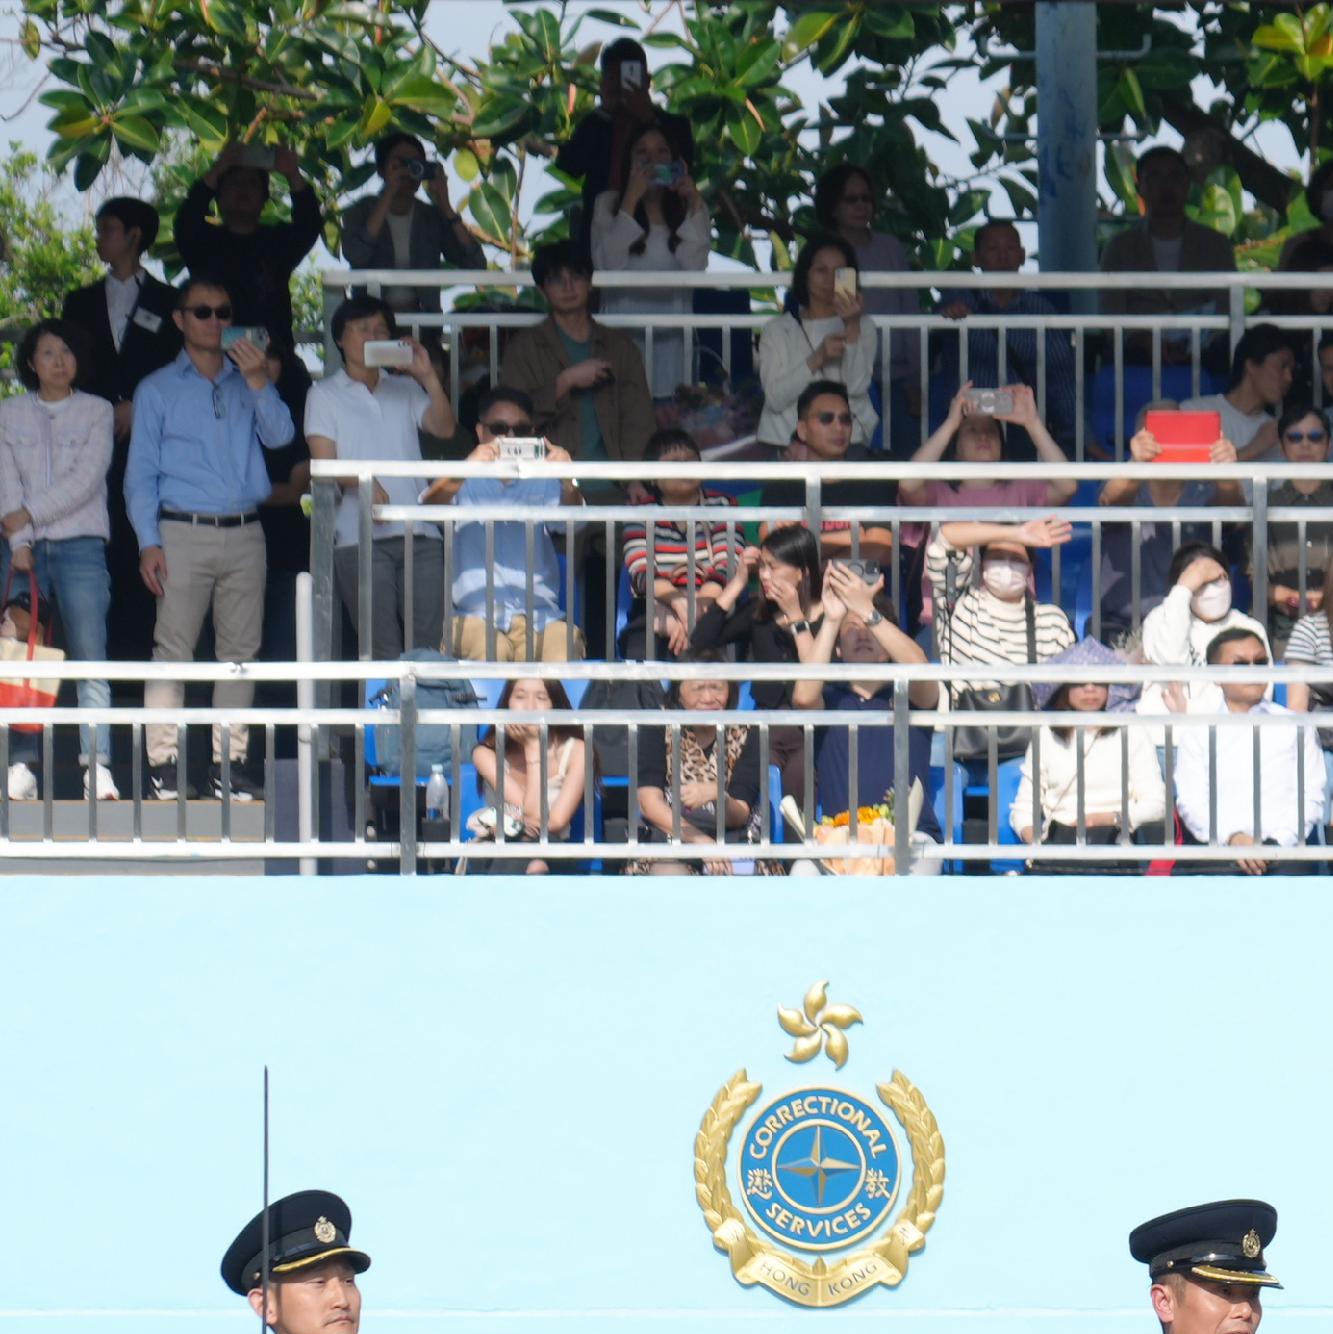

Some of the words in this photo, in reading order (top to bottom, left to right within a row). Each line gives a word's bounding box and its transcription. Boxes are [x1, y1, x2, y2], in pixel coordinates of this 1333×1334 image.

[750, 1095, 888, 1160] CORRECTIONAL
[765, 1201, 872, 1238] SERVICES
[759, 1260, 811, 1297] HONG
[827, 1261, 878, 1297] KONG
